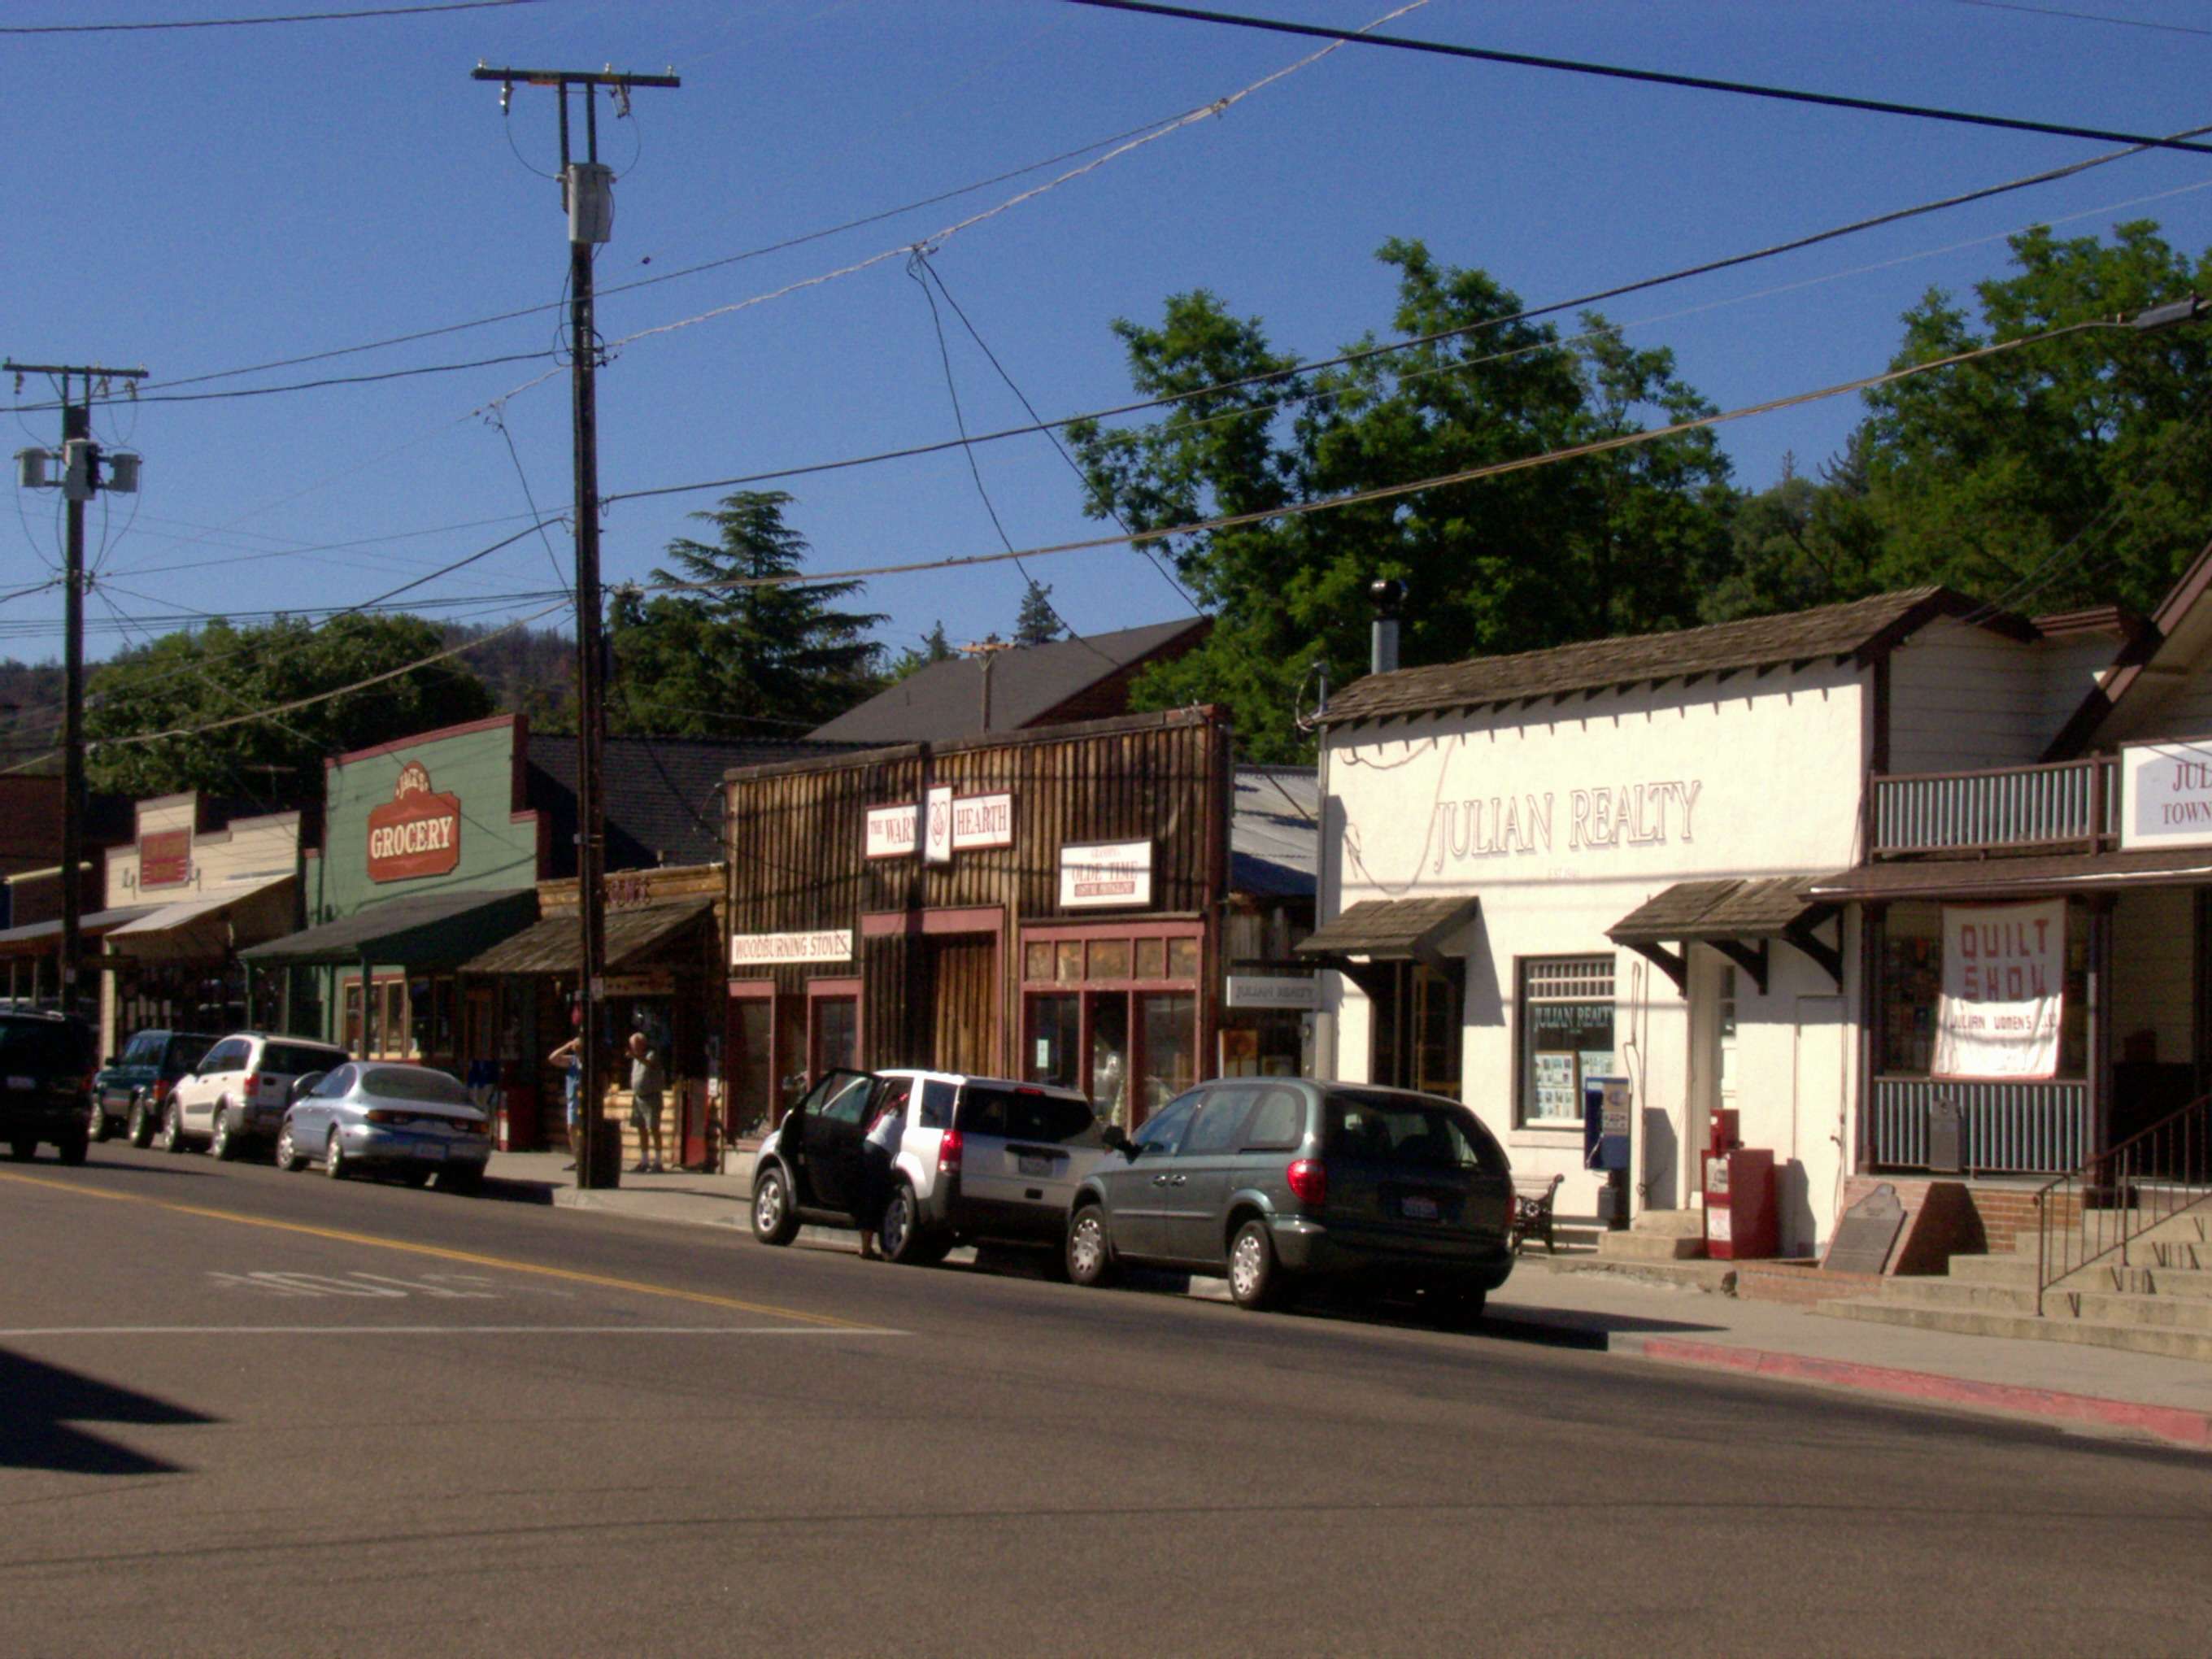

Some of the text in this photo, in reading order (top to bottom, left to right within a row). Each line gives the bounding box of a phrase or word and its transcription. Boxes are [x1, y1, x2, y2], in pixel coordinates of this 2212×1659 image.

[956, 804, 1008, 835] HEARTH
[1434, 780, 1702, 874] JULIAN REALTY
[371, 816, 453, 860] GROCERY
[1072, 860, 1139, 883] OLDE TIME
[735, 935, 848, 960] WOODBURNING STOVES
[1961, 918, 2050, 960] QUILT
[1963, 964, 2048, 1002] SHOW
[1535, 1006, 1574, 1033] JULIAN
